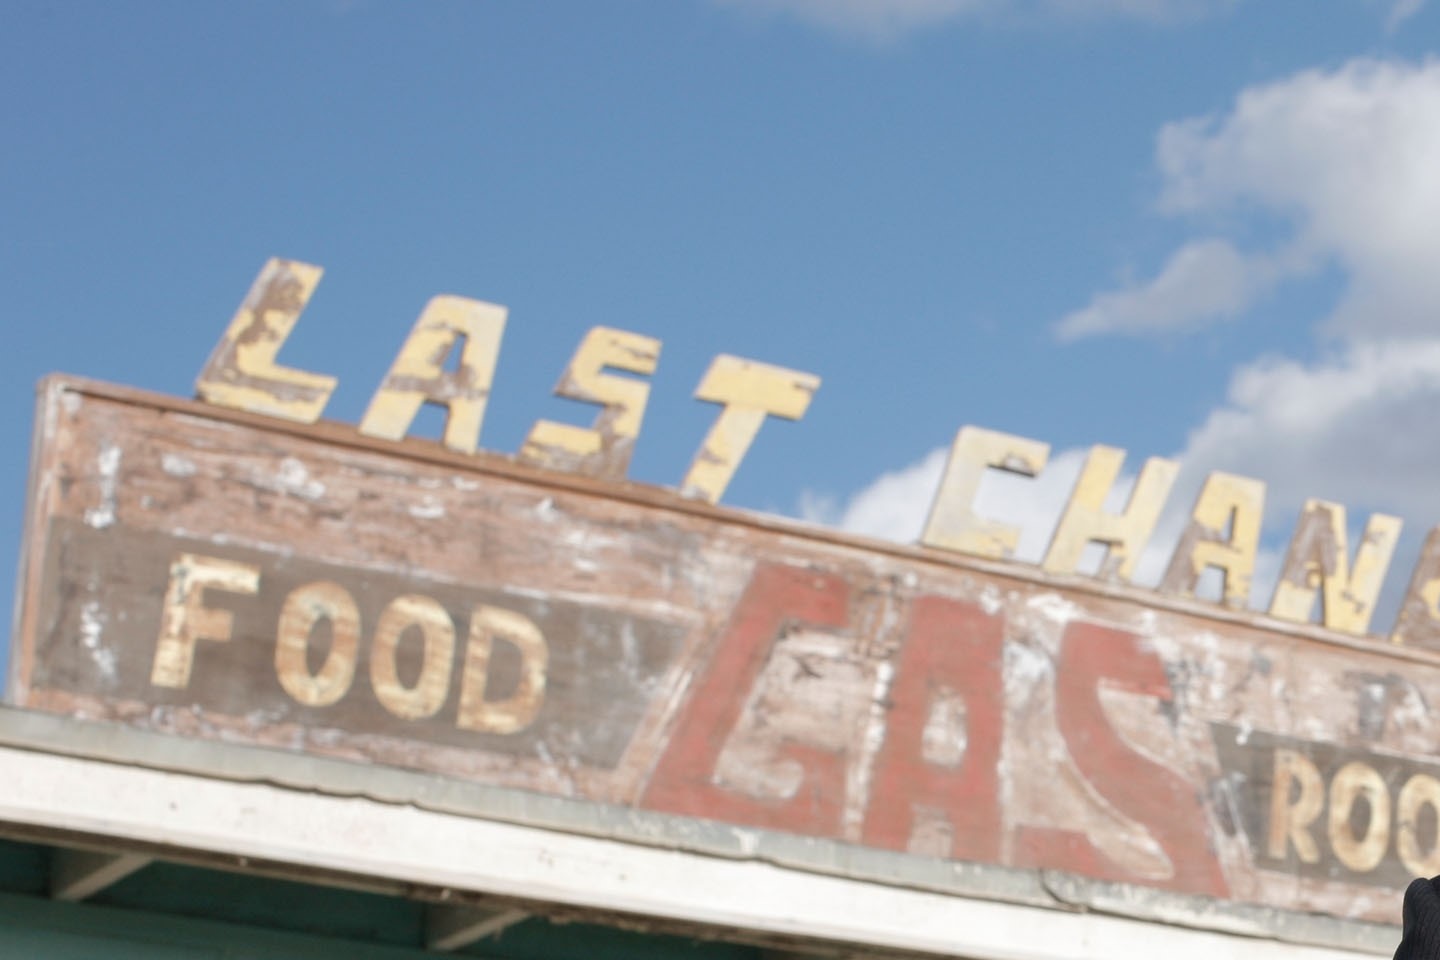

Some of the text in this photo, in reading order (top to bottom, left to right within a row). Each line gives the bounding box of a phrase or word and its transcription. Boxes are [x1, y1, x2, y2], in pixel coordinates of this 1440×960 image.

[196, 257, 821, 504] LAST
[151, 553, 549, 735] FOOD
[640, 558, 1232, 899] GAS
